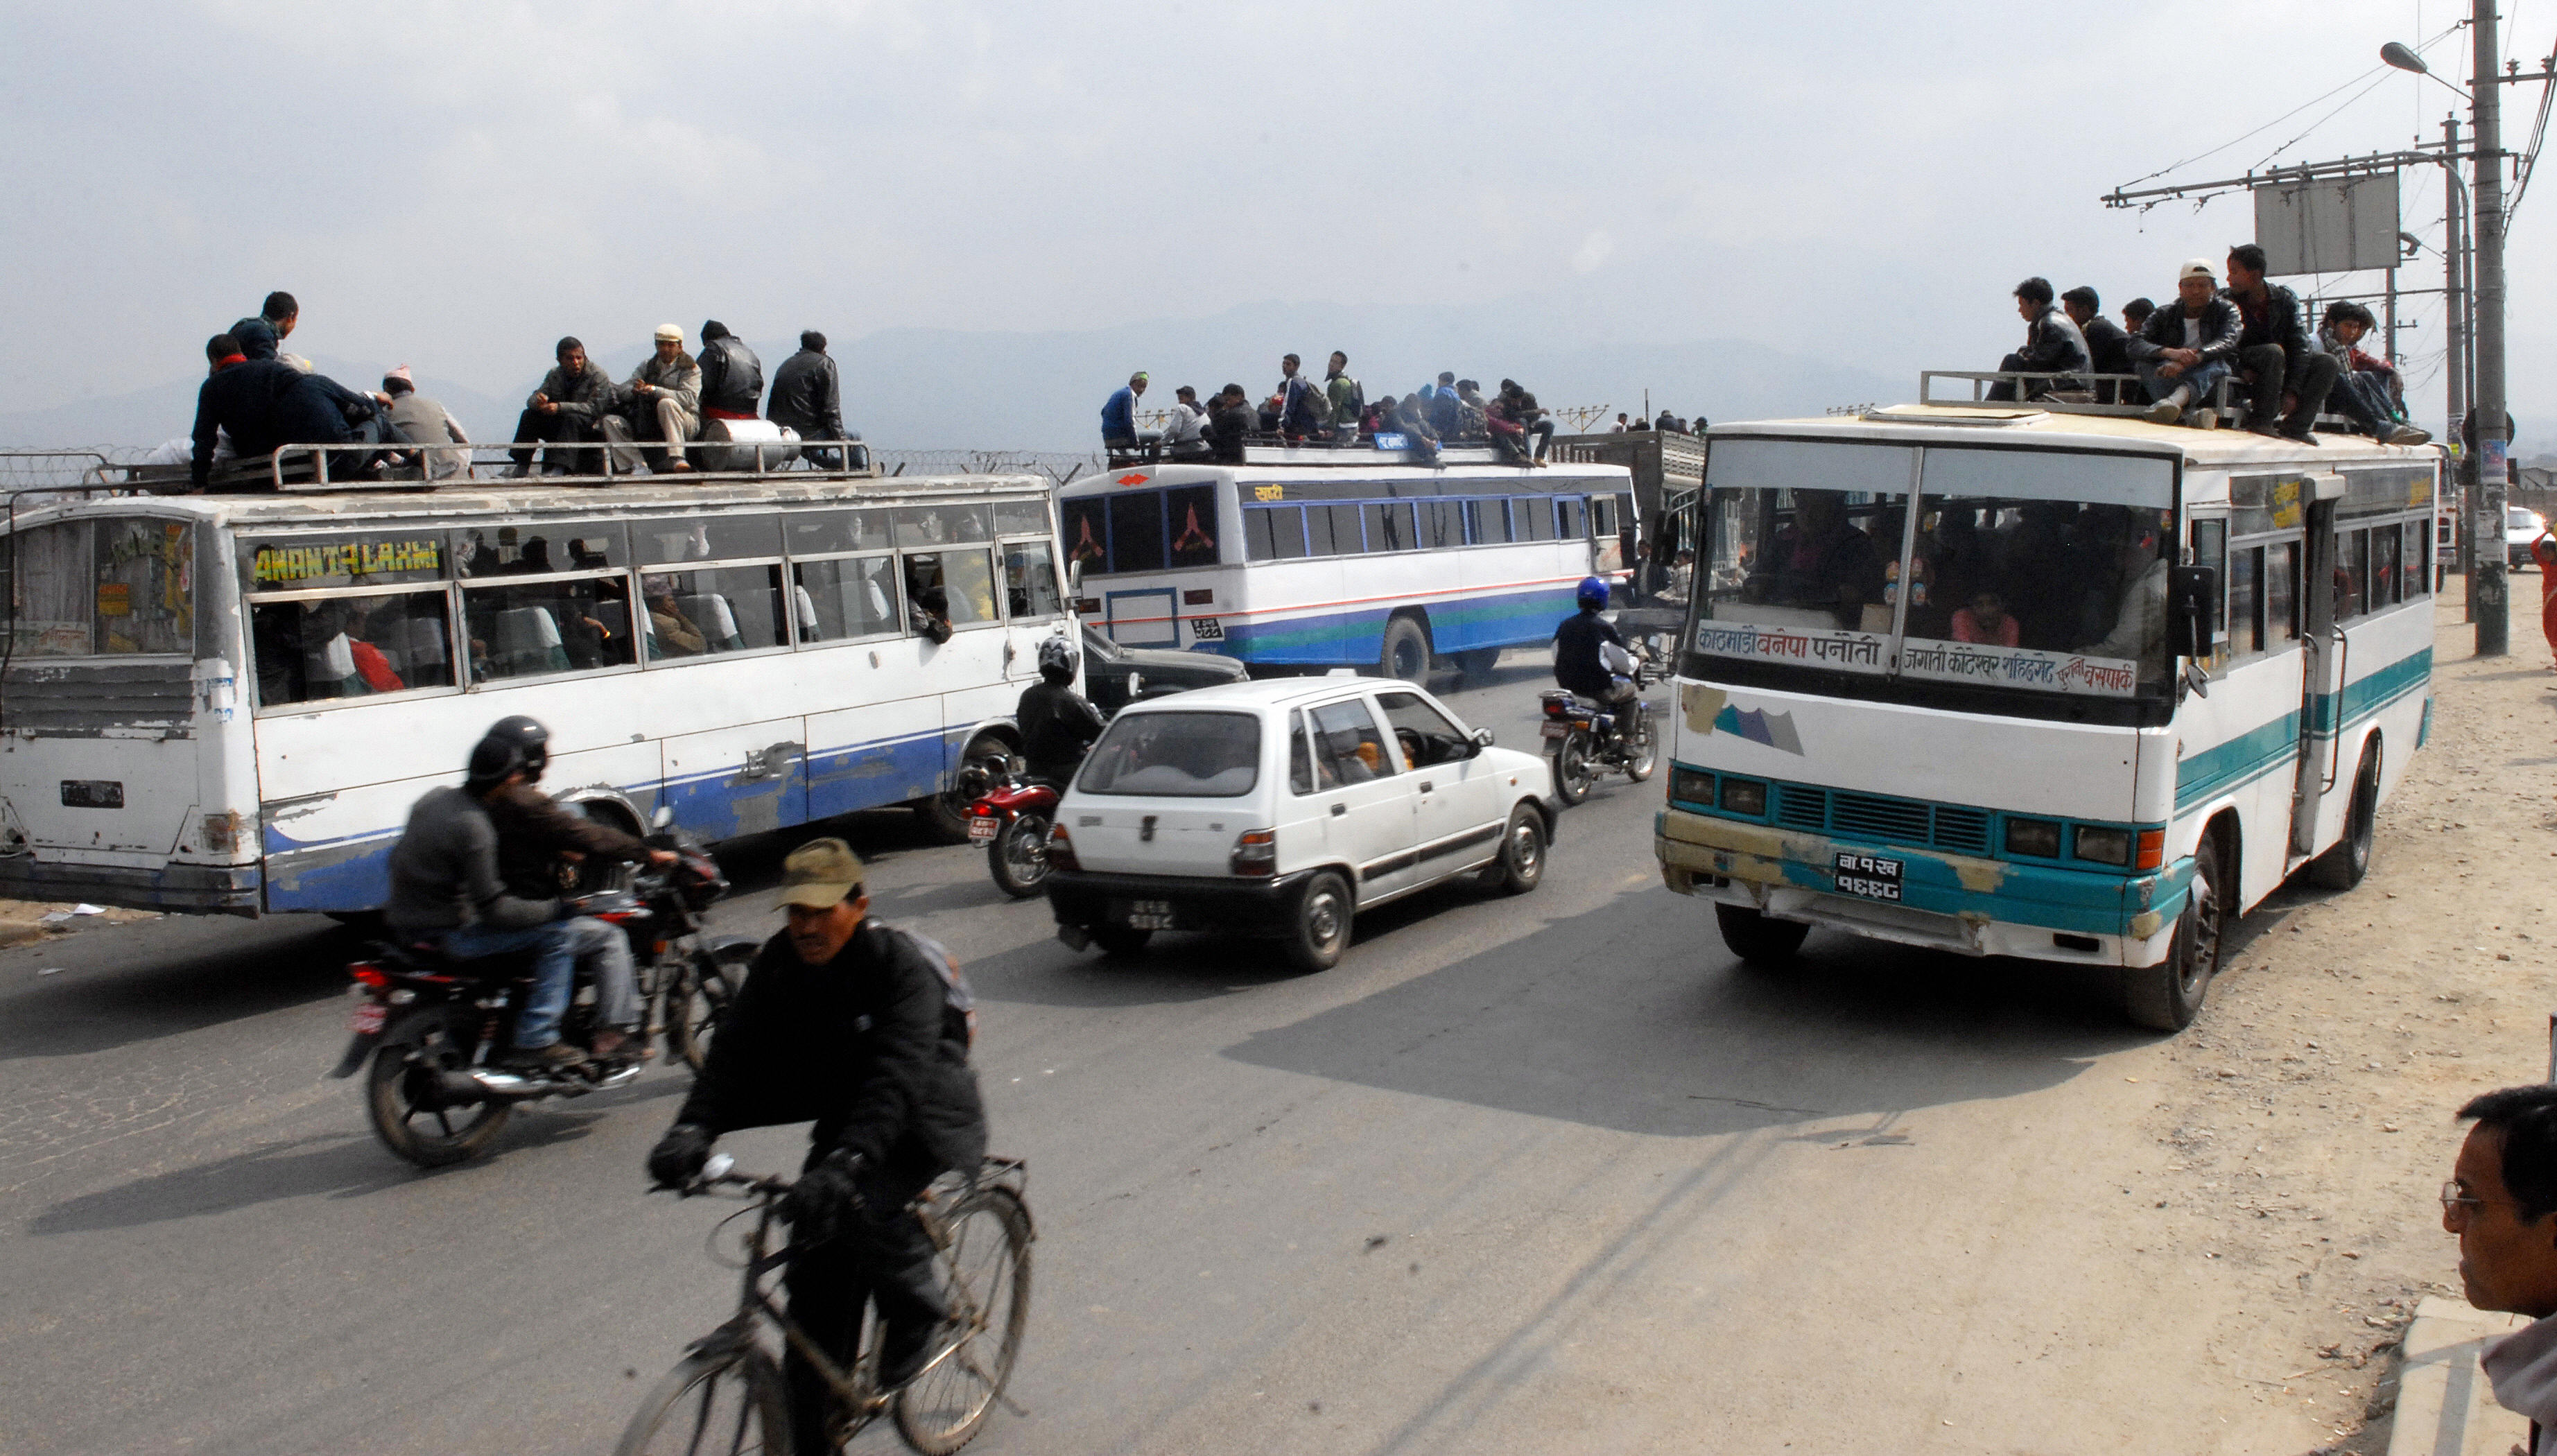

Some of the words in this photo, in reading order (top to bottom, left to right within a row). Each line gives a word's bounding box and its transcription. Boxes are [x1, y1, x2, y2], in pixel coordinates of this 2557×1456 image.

[1812, 632, 1882, 666] पनौती
[1904, 643, 1947, 673] जगाती
[1948, 646, 2000, 680] कोटेश्वर
[1839, 876, 1898, 899] १६६८
